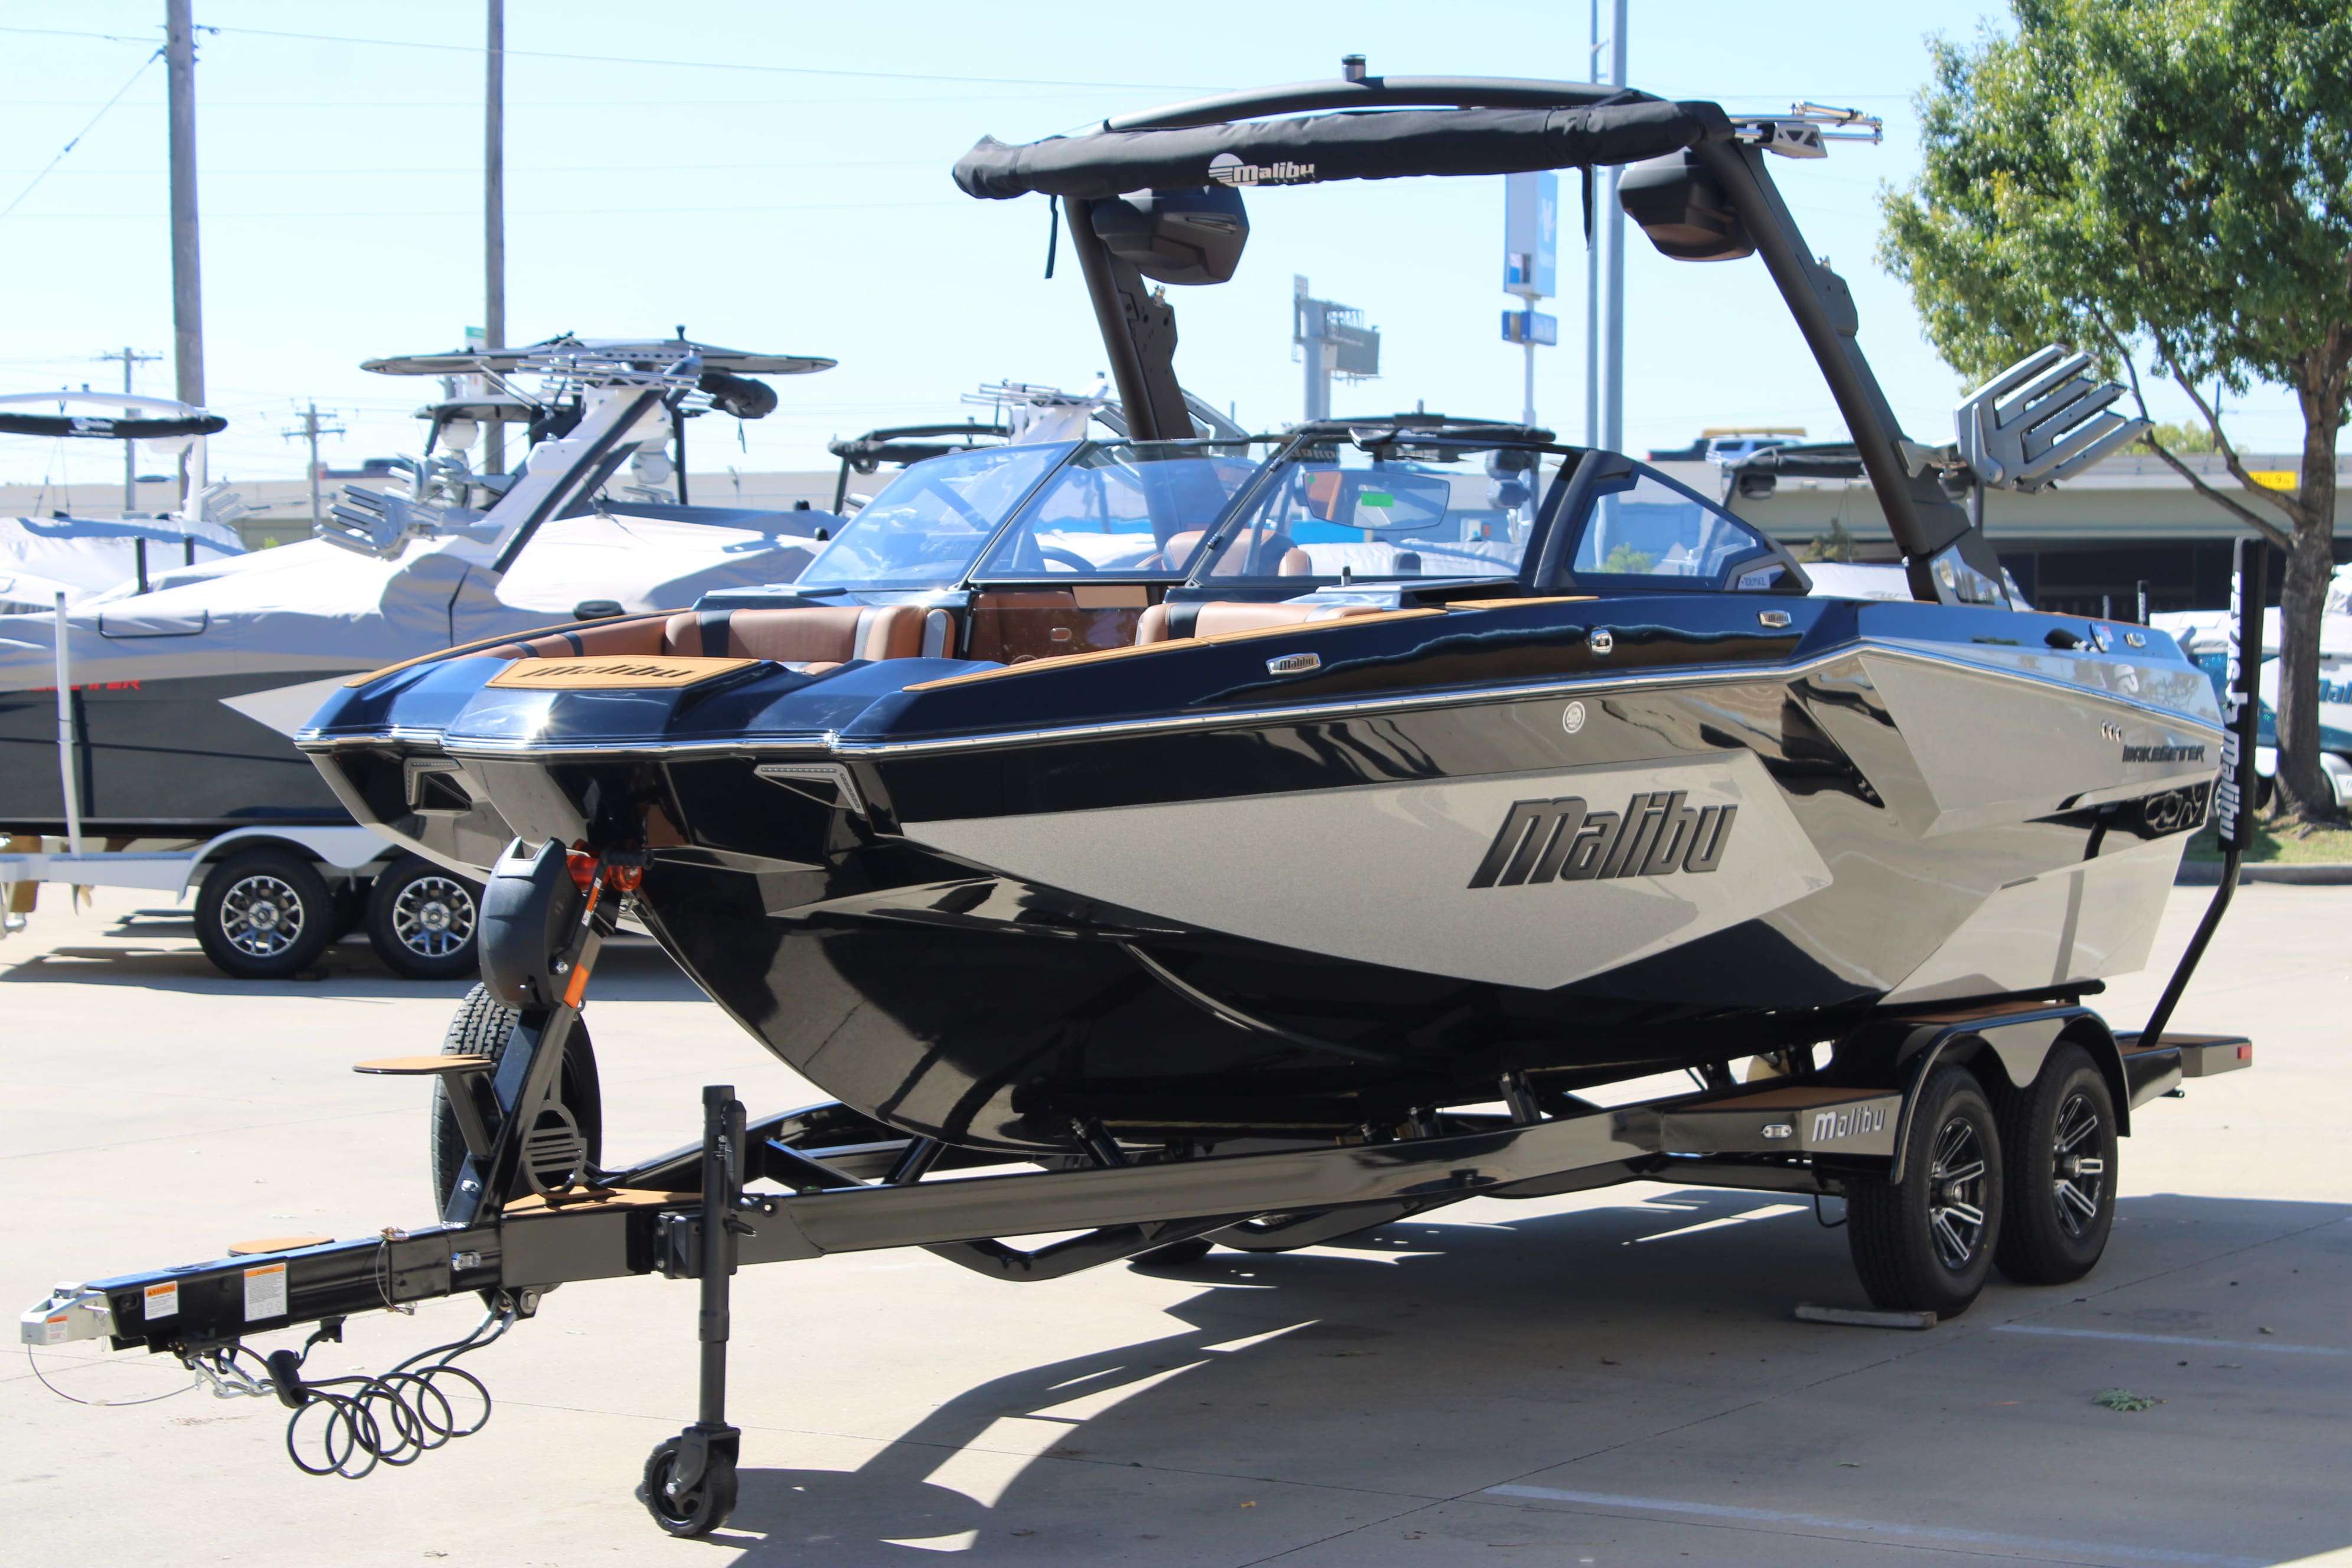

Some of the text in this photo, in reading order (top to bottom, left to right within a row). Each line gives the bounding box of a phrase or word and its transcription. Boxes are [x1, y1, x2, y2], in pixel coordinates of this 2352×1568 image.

[1233, 161, 1315, 182] Malibu
[1466, 790, 1739, 888] Malibu
[1811, 1105, 1886, 1142] Malibu
